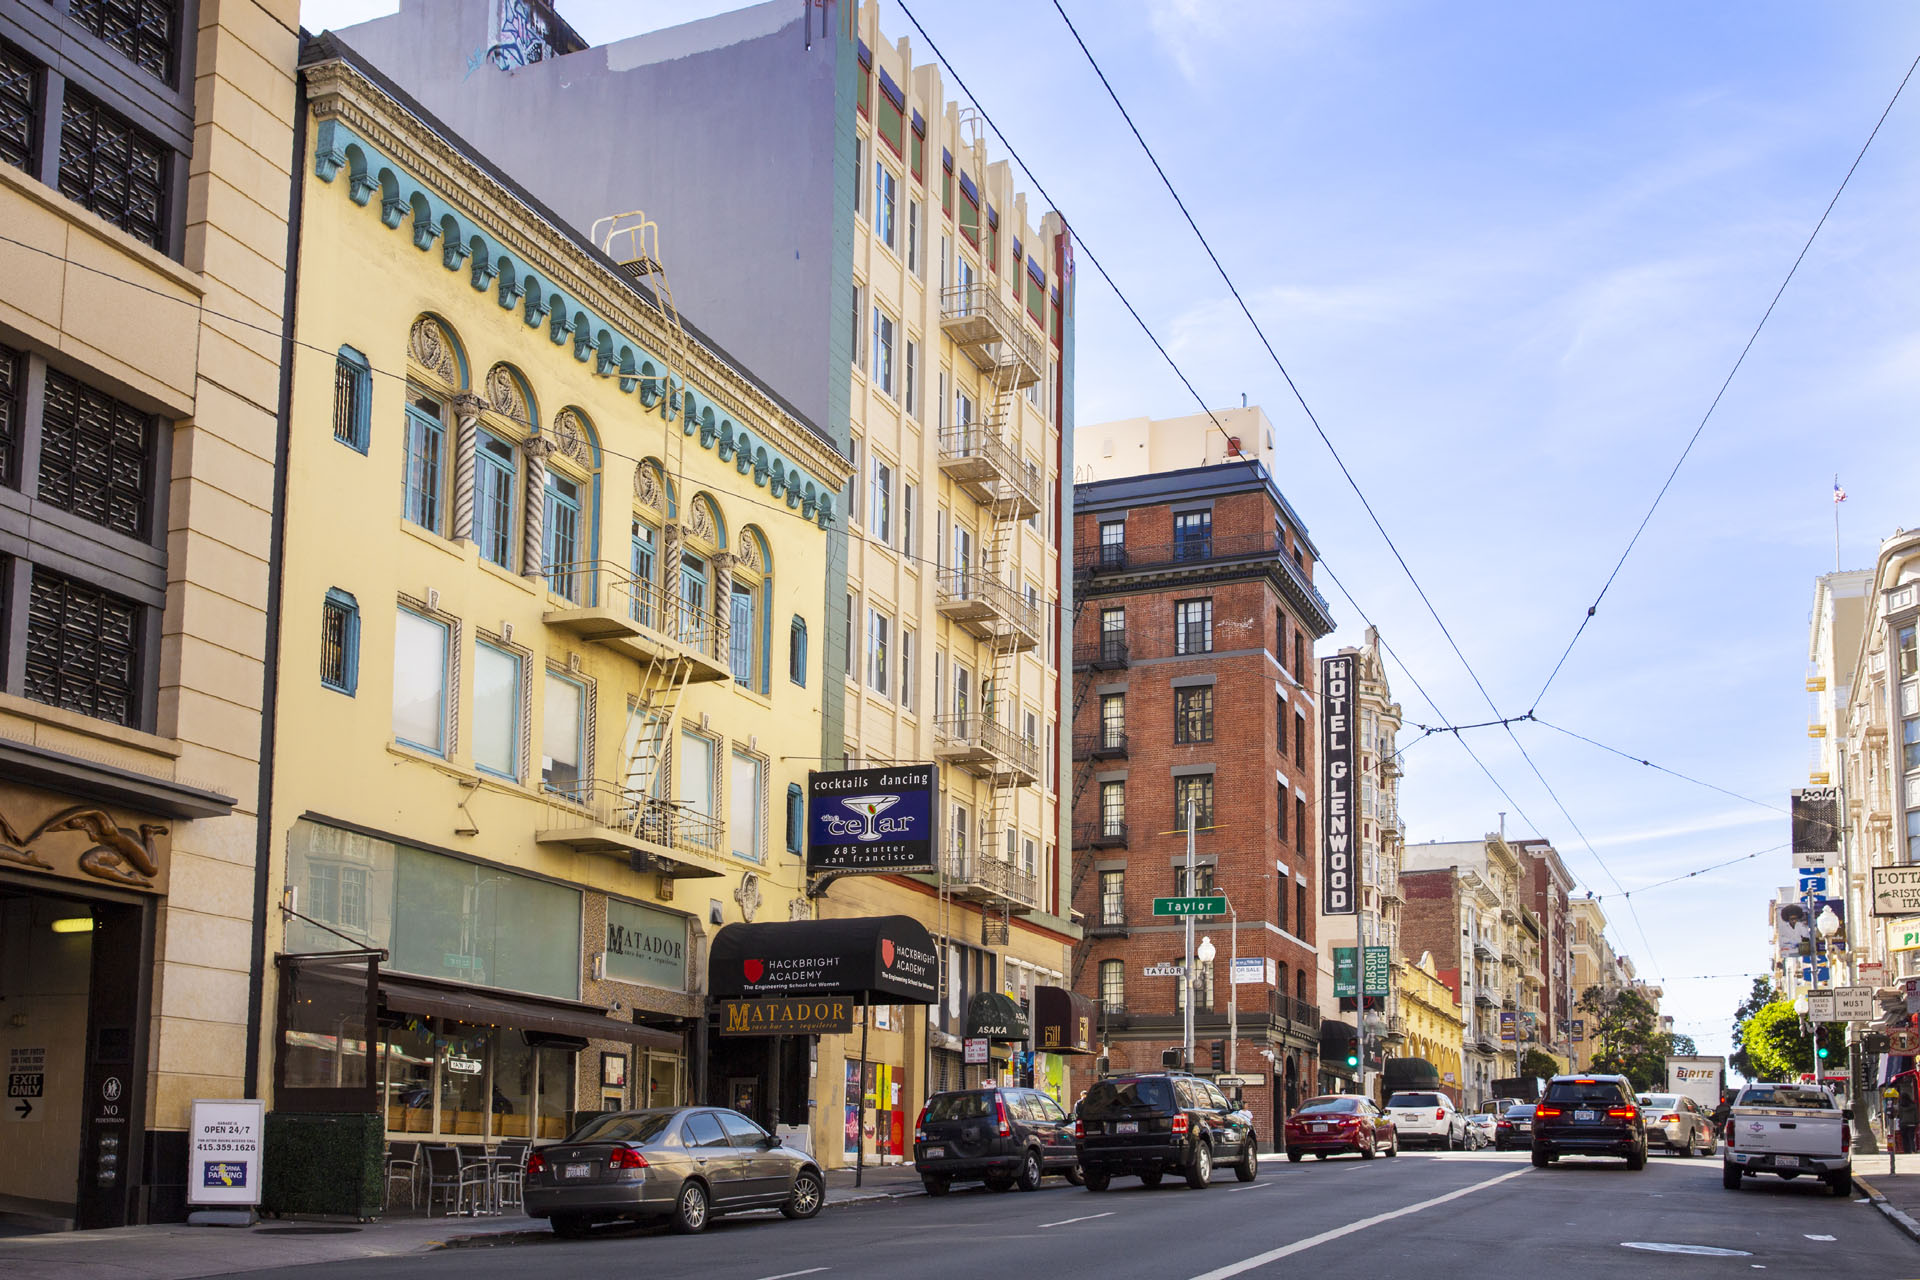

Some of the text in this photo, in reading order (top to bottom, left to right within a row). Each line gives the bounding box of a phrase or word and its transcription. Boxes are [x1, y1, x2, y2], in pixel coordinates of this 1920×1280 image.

[814, 773, 928, 790] cocktails dancing
[1329, 661, 1348, 908] HOTEL GLENWOOD
[1800, 787, 1837, 801] bold
[821, 814, 840, 822] the
[834, 845, 905, 855] 685 sutter
[853, 853, 914, 862] francisco
[1167, 902, 1213, 913] Taylor
[607, 922, 681, 959] MATADOR
[896, 945, 935, 965] HACKBRIGHT
[769, 957, 840, 968] HACKBRIGHT
[896, 960, 926, 976] ACADEMY
[769, 970, 822, 980] ACADEMY
[1366, 952, 1376, 990] BABSON
[1377, 952, 1388, 990] COLLEGE
[726, 1003, 845, 1032] MATADOR
[770, 1022, 782, 1030] bar
[977, 1026, 1007, 1034] ASAKA
[13, 1074, 40, 1085] EXIT
[10, 1085, 40, 1096] ONLY
[104, 1105, 118, 1115] NO
[204, 1126, 250, 1134] OPEN 24/7
